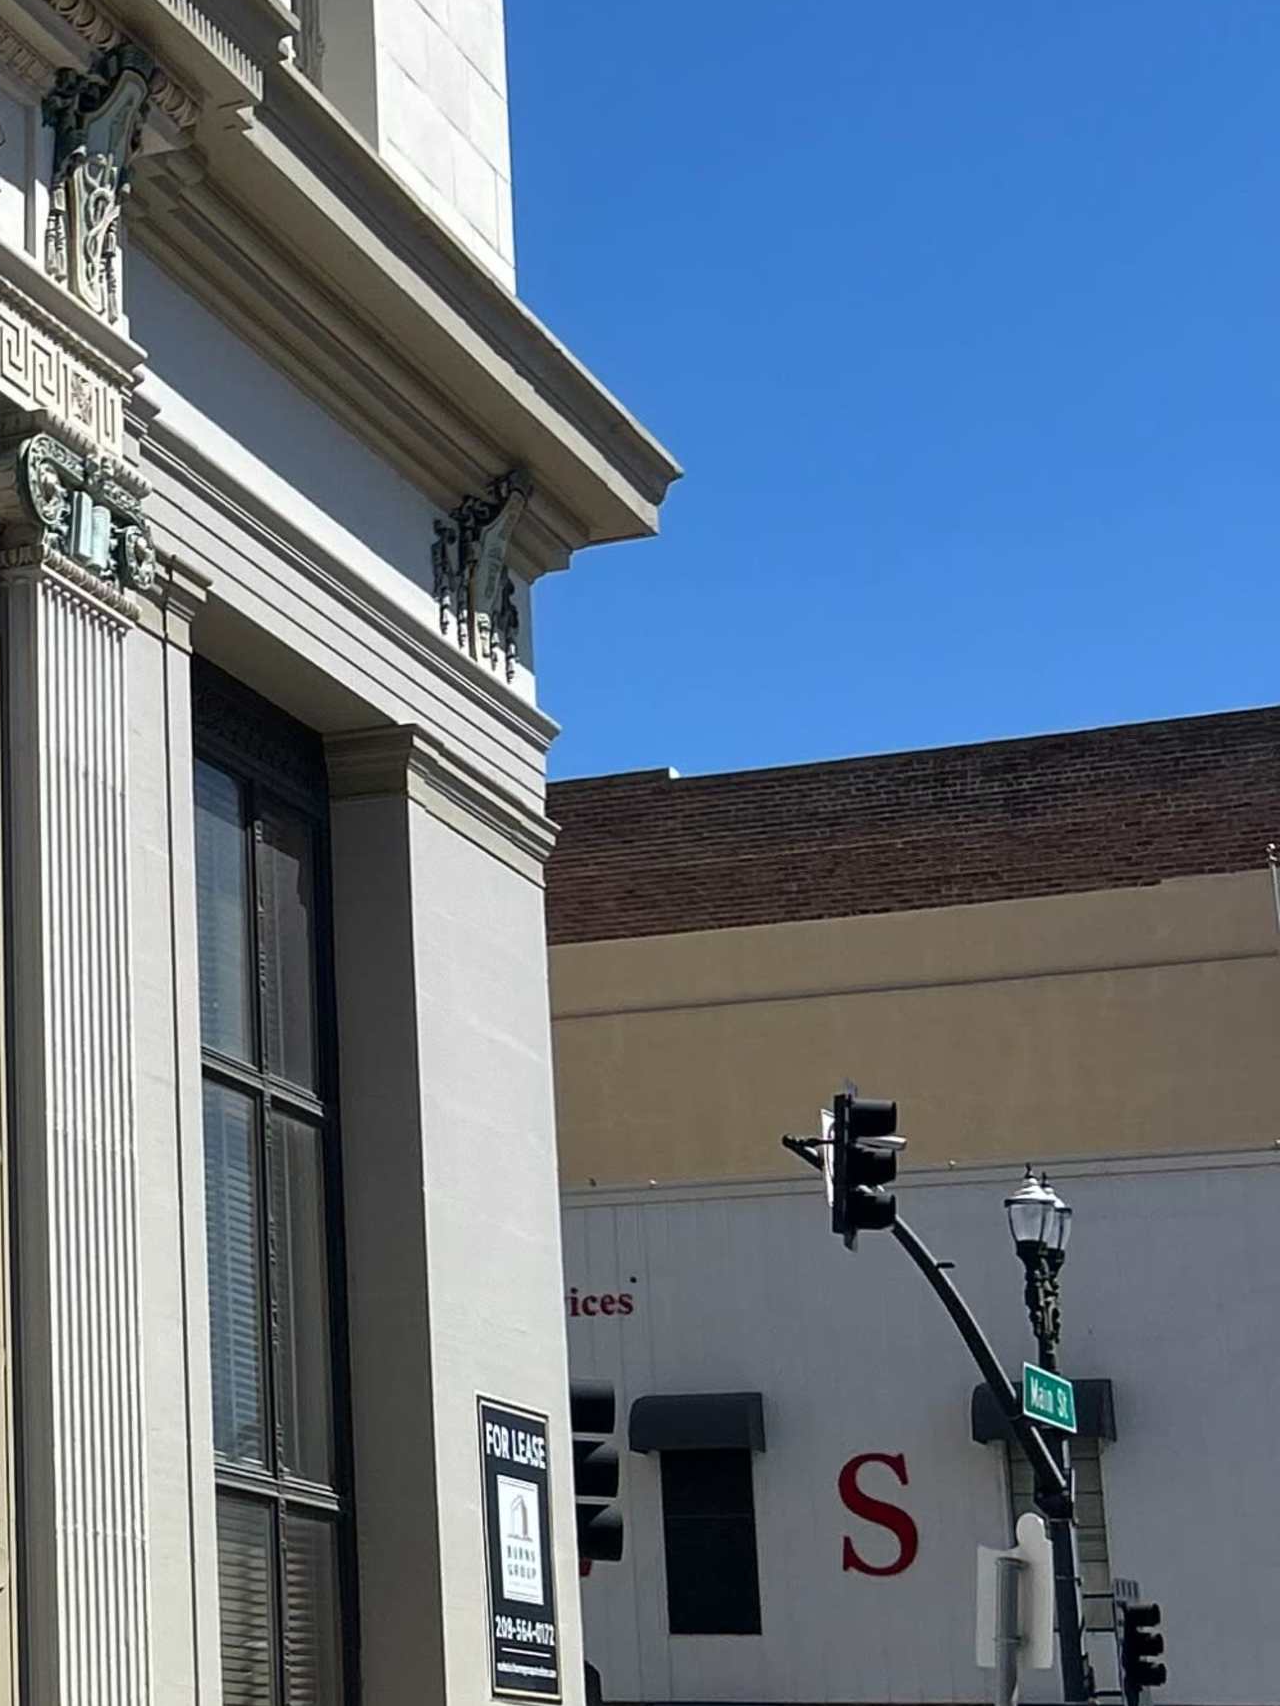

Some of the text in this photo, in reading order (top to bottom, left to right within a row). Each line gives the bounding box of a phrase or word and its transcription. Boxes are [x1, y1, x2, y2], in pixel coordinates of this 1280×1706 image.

[565, 1287, 634, 1317] ices
[1030, 1376, 1053, 1413] Main
[485, 1421, 546, 1469] FOR LEASE
[838, 1452, 918, 1576] S
